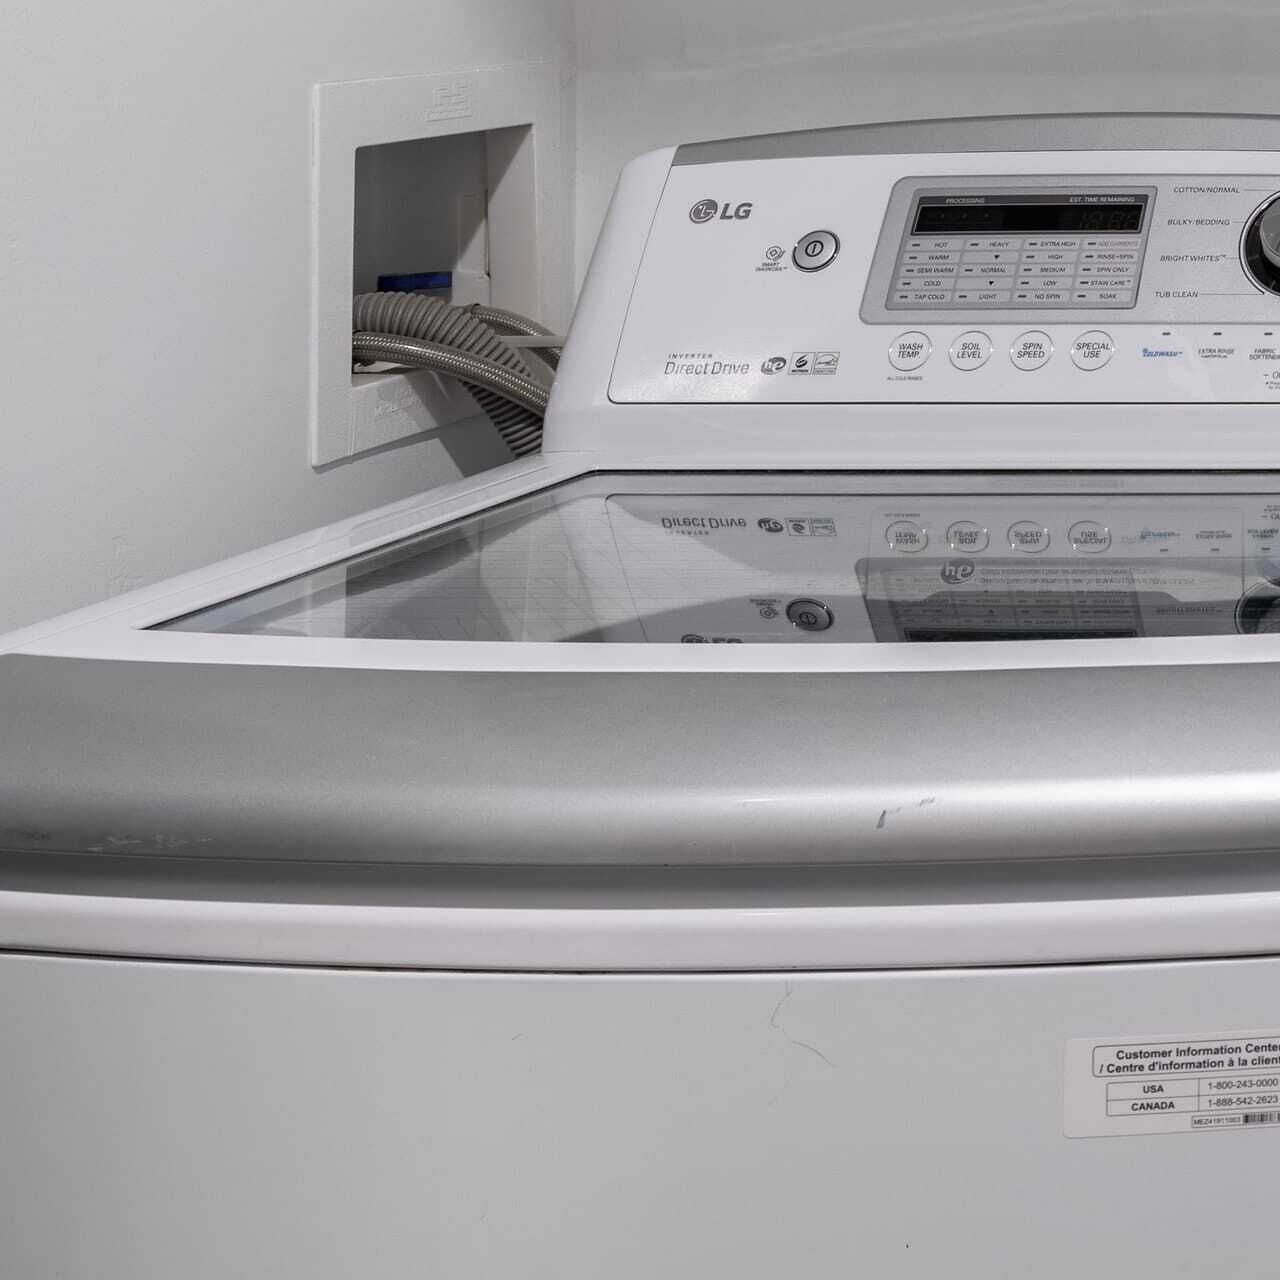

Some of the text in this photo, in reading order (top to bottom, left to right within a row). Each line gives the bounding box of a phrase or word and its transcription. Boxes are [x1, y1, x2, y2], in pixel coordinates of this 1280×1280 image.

[899, 342, 924, 351] WASH
[961, 342, 981, 351] SOIL
[1022, 342, 1043, 351] SPIN
[1076, 342, 1111, 351] SPECIAL
[897, 351, 921, 359] TEMP.
[957, 350, 982, 359] LEVEL
[1017, 350, 1045, 359] SPEED
[1083, 350, 1101, 359] USE
[664, 361, 750, 375] Direct Drive
[1116, 1049, 1173, 1061] Customer
[1176, 1045, 1242, 1058] Information
[1107, 1062, 1145, 1074] Centre
[1148, 1058, 1225, 1072] d'information
[1228, 1057, 1235, 1068] à
[1238, 1056, 1248, 1067] la
[1143, 1078, 1279, 1094] USA 1-800-243-0000
[1131, 1101, 1175, 1112] CANADA
